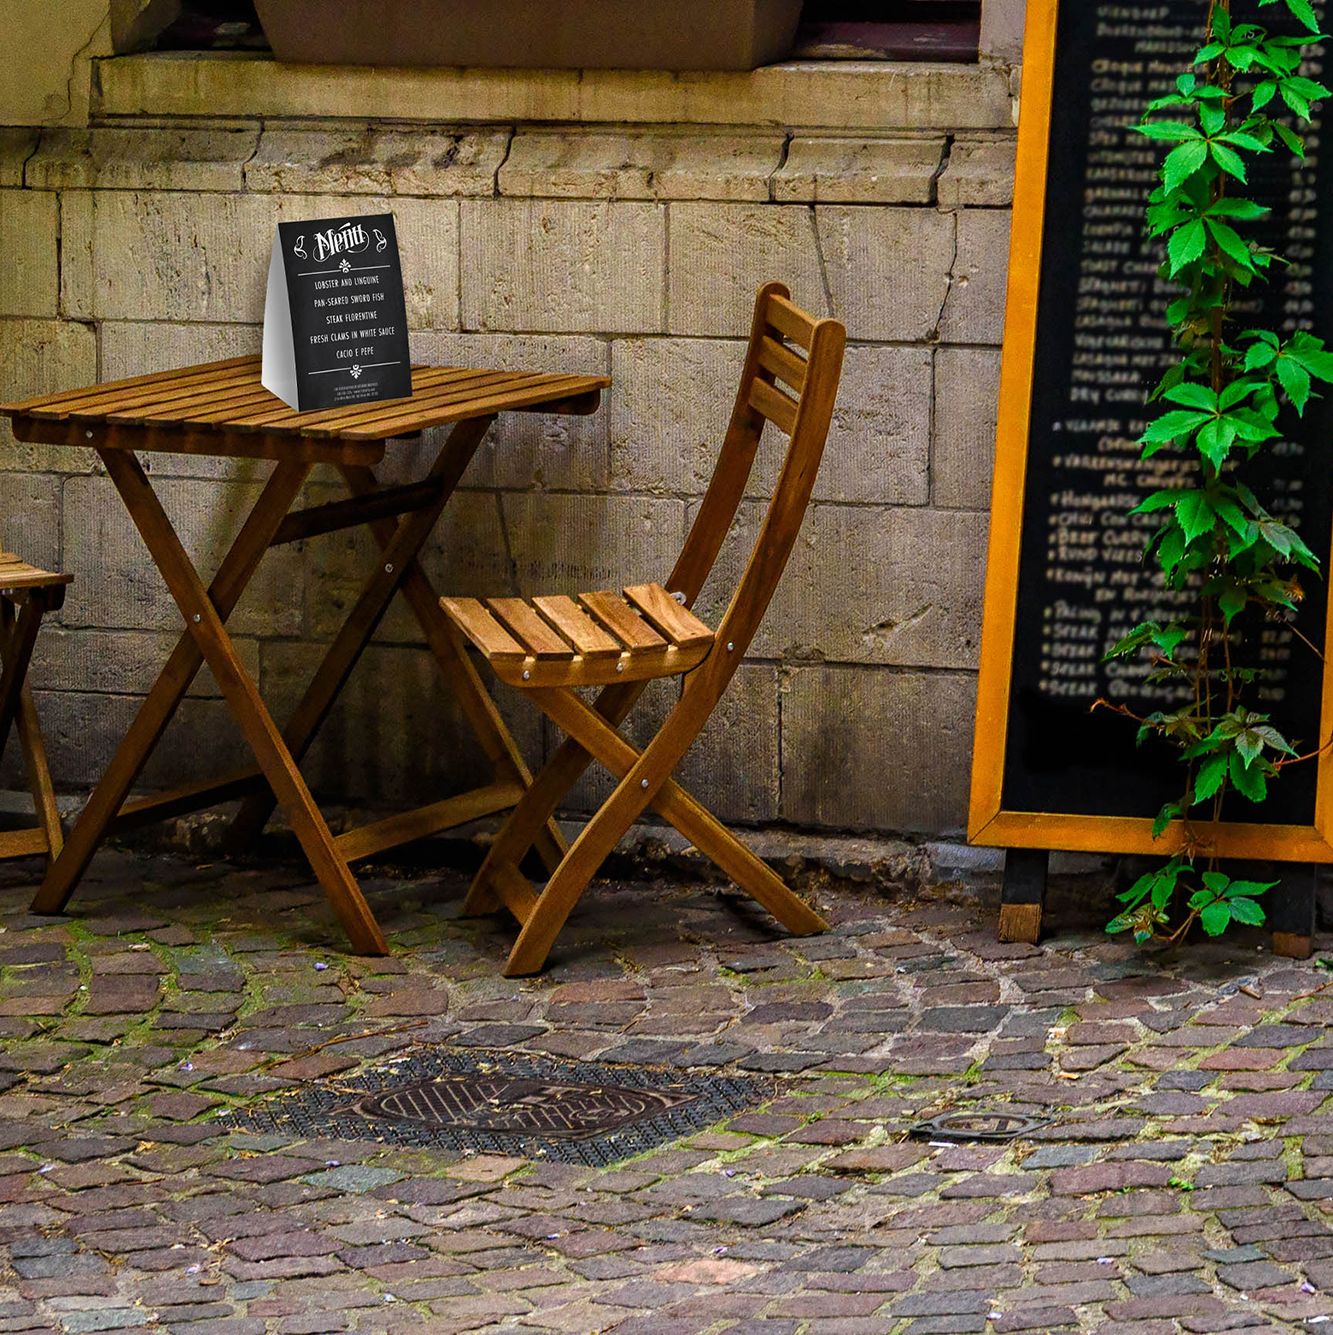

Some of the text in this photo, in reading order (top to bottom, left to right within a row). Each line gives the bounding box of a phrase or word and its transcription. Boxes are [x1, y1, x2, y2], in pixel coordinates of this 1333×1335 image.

[315, 275, 379, 290] LOBSTER AND LINGUINE
[314, 293, 384, 307] PAN-SEARED SWORD FISH
[326, 311, 377, 324] STEAK FLORENTINE
[310, 326, 395, 344] FRESH CLAMS IN WHITE SAUCE
[336, 346, 374, 359] CACIO E PEPE
